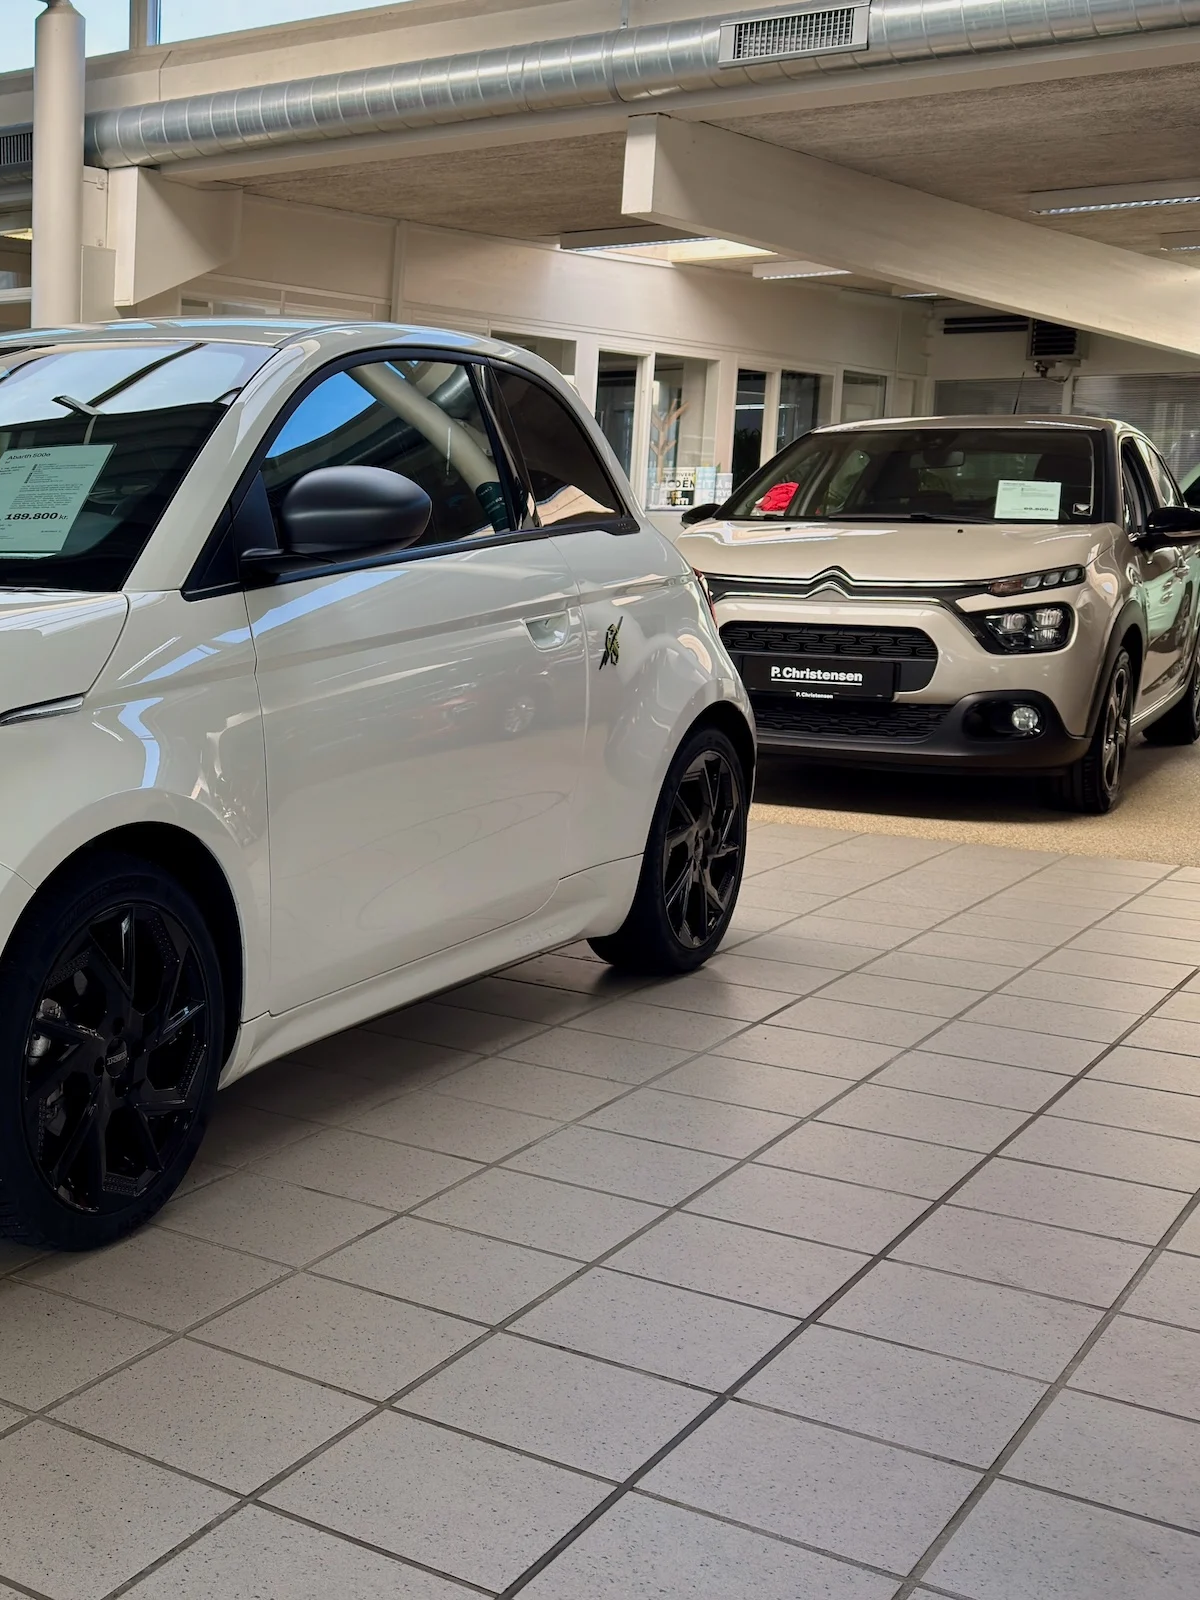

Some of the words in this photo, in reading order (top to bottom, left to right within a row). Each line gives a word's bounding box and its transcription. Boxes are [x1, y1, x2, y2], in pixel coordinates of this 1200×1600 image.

[7, 453, 31, 461] Abarth
[4, 512, 58, 520] 189.800
[782, 667, 863, 682] Christensen
